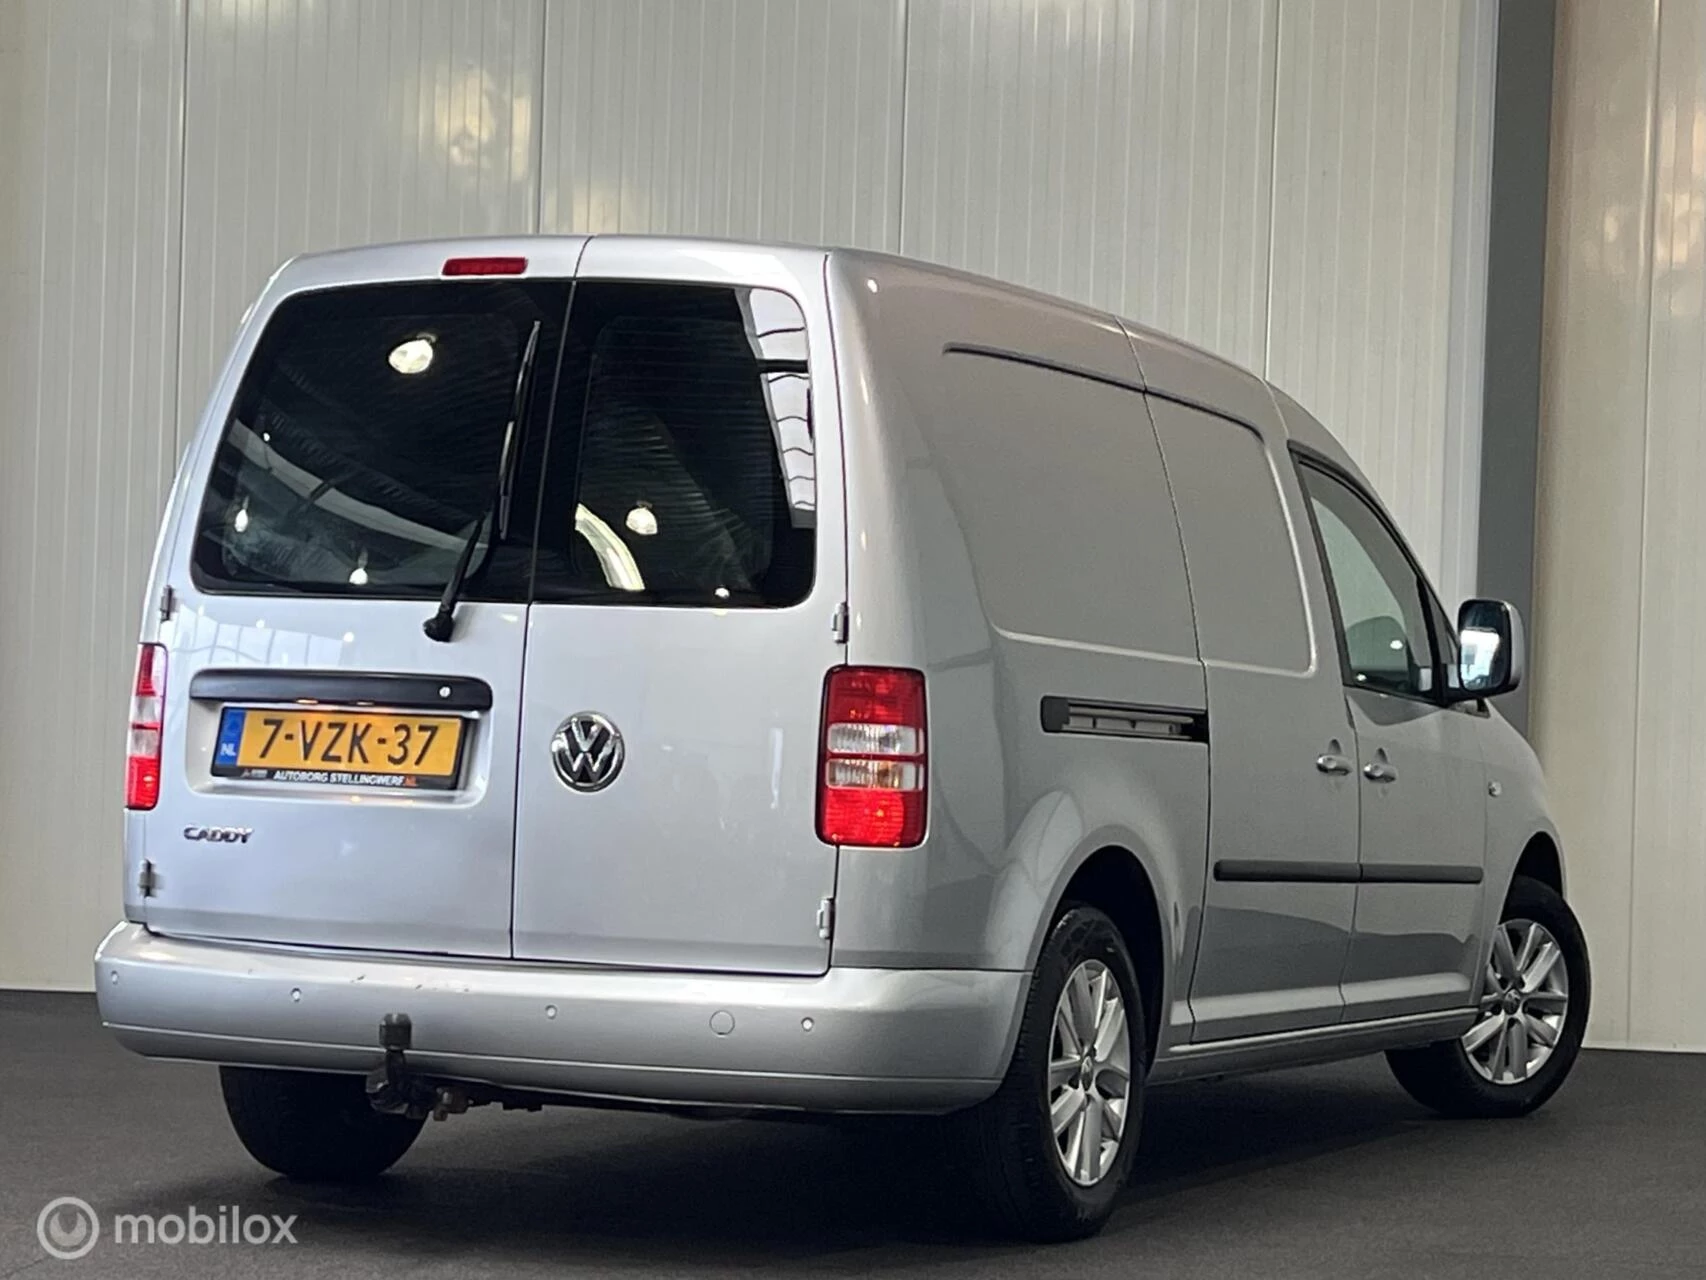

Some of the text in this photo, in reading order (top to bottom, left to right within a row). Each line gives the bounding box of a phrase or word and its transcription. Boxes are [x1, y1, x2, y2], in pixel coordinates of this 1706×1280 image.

[220, 743, 236, 757] NL
[259, 718, 439, 766] 7-VZK-37
[273, 770, 329, 783] AUTOBORG
[183, 826, 255, 844] CADDY
